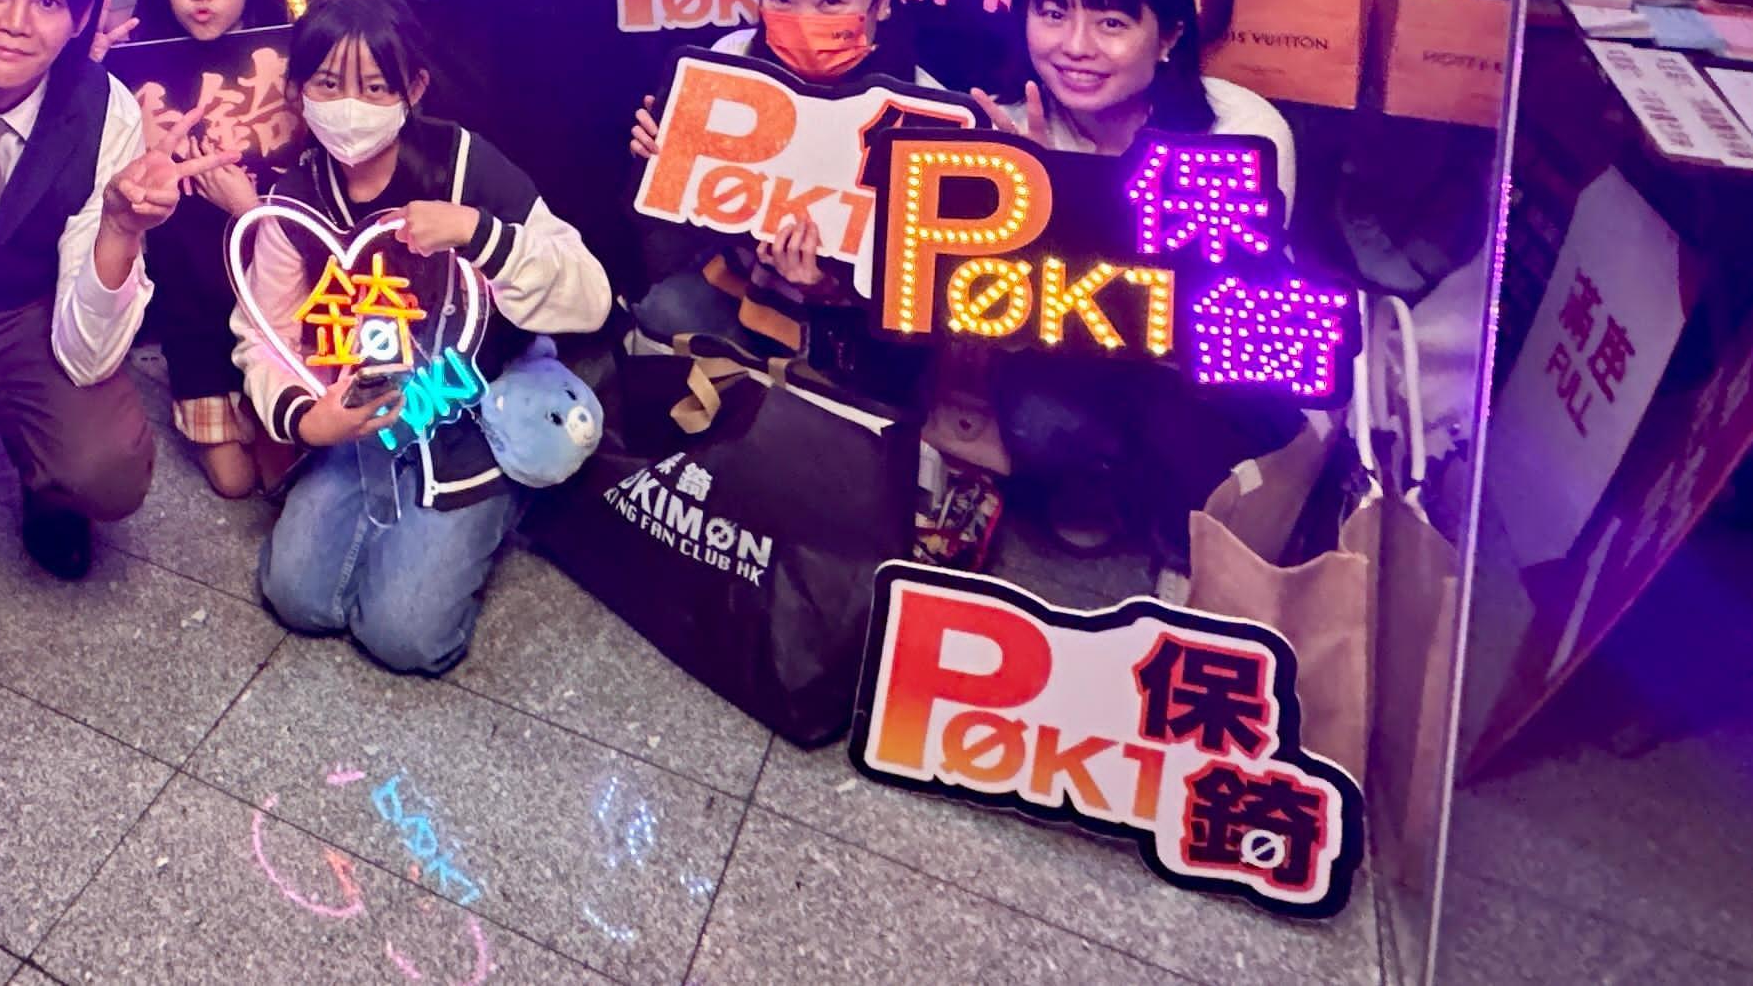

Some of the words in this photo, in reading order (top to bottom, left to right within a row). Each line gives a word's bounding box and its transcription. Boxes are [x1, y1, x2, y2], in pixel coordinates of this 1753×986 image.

[640, 514, 675, 548] FAN
[680, 537, 731, 571] CLUB
[736, 560, 765, 587] HK
[1133, 631, 1330, 889] 保錡
